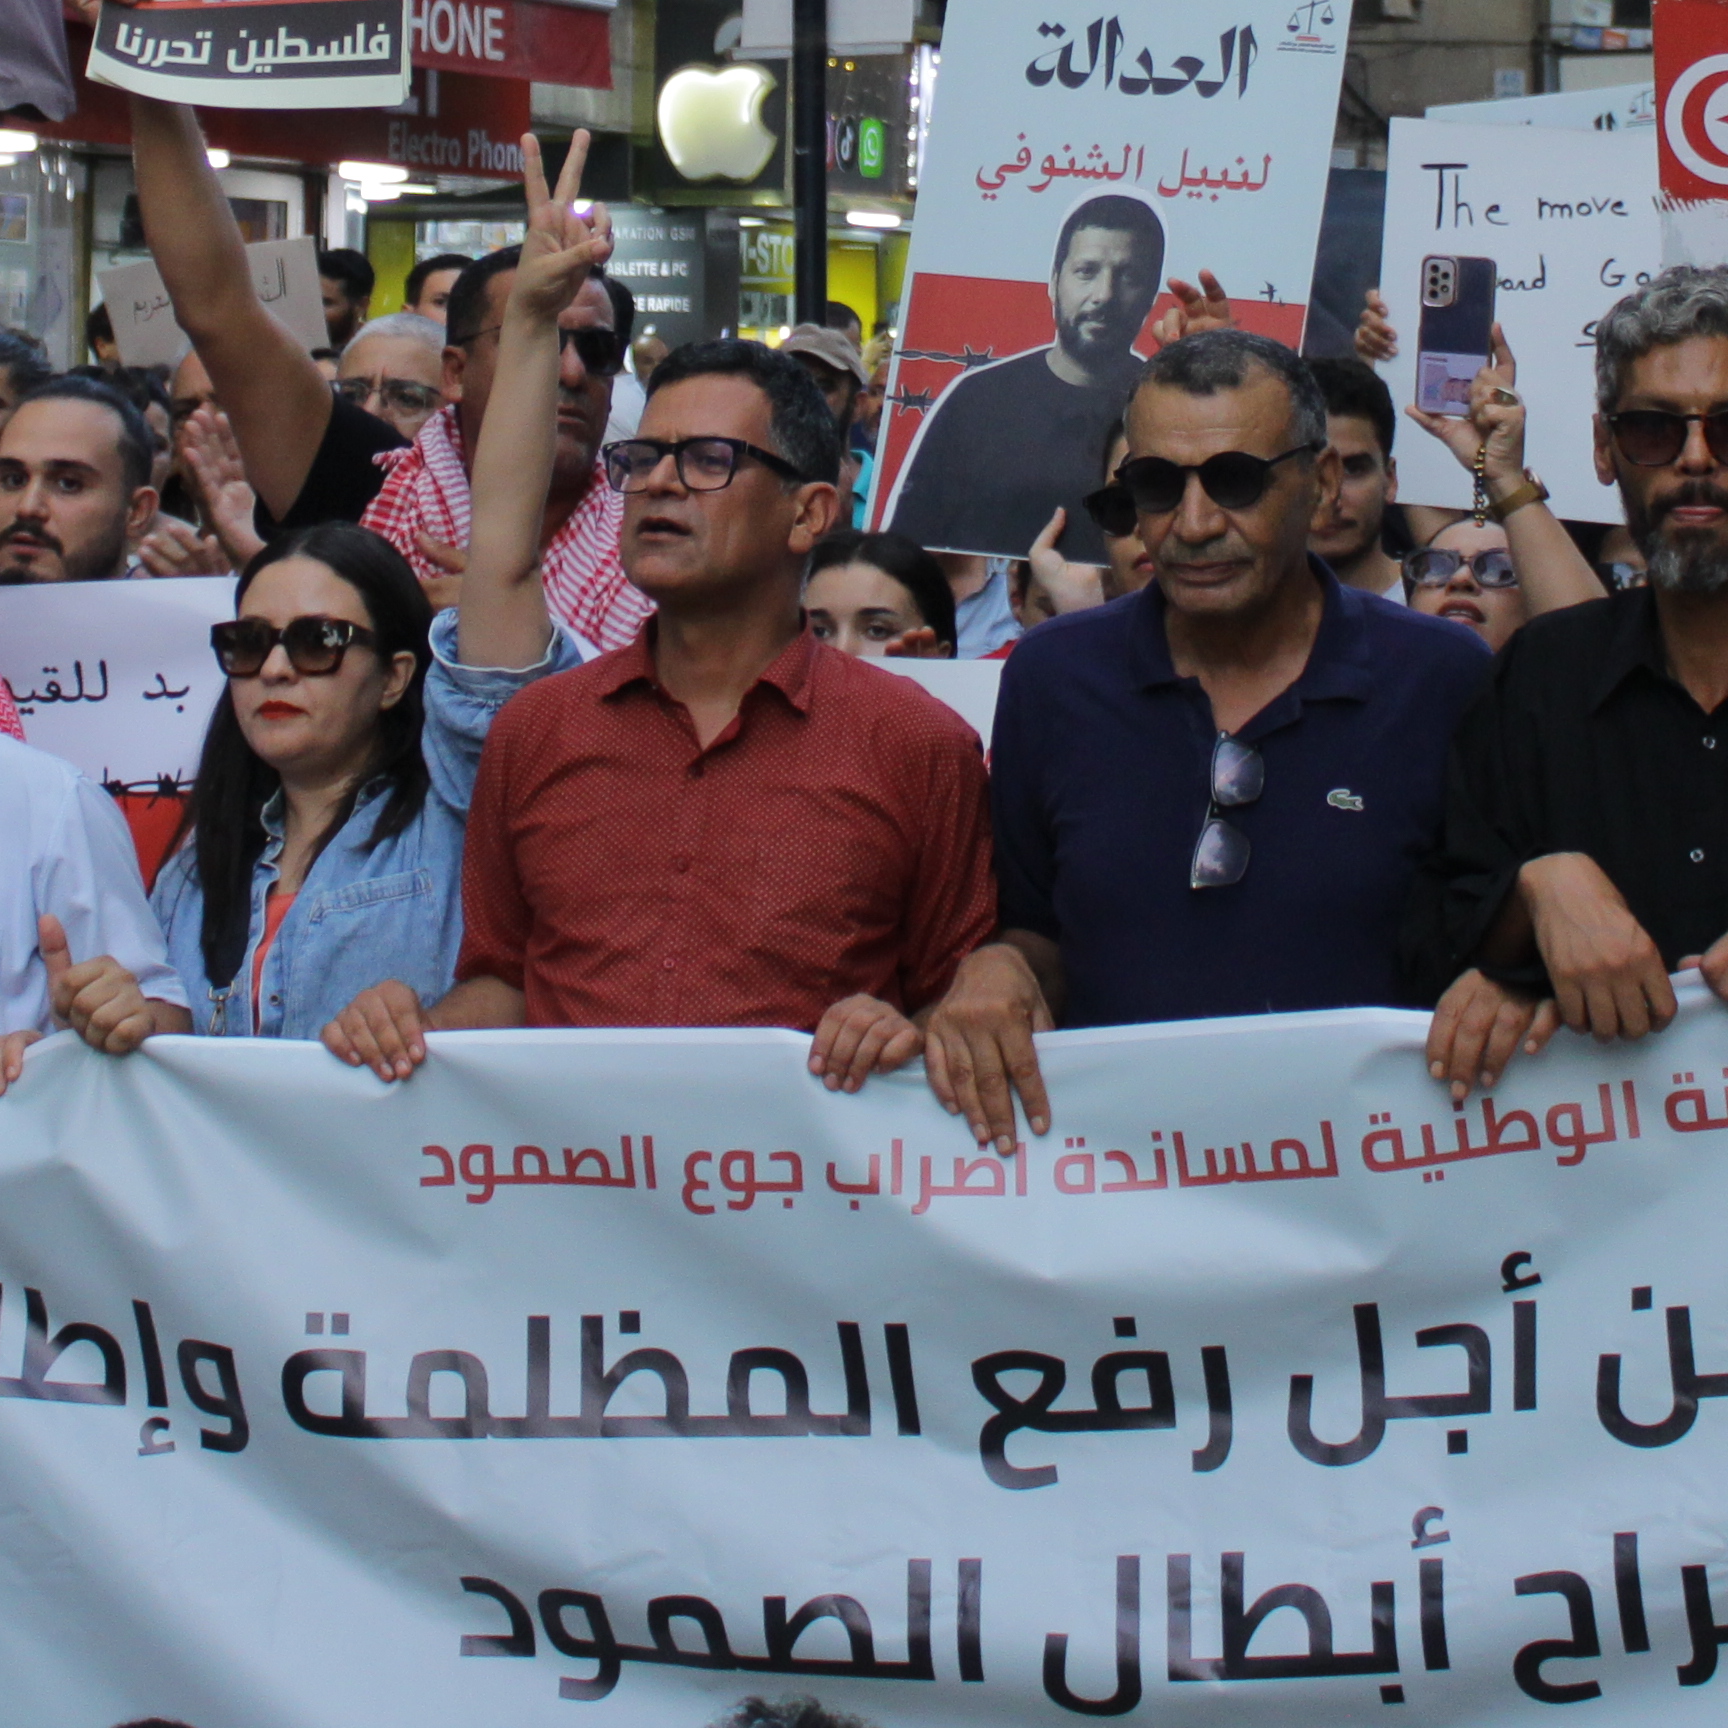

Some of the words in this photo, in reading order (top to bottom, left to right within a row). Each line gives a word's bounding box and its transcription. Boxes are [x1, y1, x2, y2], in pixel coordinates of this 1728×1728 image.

[115, 22, 213, 68] تحررنا
[226, 23, 392, 75] فلسطين
[1025, 14, 1258, 100] العدالة
[387, 121, 462, 168] Electro
[975, 132, 1145, 202] الشنوفي
[1156, 147, 1272, 202] لنبيل
[1421, 163, 1509, 230] The
[647, 296, 692, 314] RAPIDE
[142, 672, 190, 714] بد
[1053, 1120, 1341, 1197] لمساندة
[1360, 1080, 1643, 1184] الوطنية
[419, 1134, 659, 1206] الصمود
[679, 1144, 805, 1217] جوع
[279, 1309, 922, 1442] المظلمة
[1285, 1249, 1543, 1469] أجل
[969, 1315, 1236, 1492] رفع
[459, 1556, 986, 1703] الصمود
[1041, 1504, 1453, 1719] أبطال
